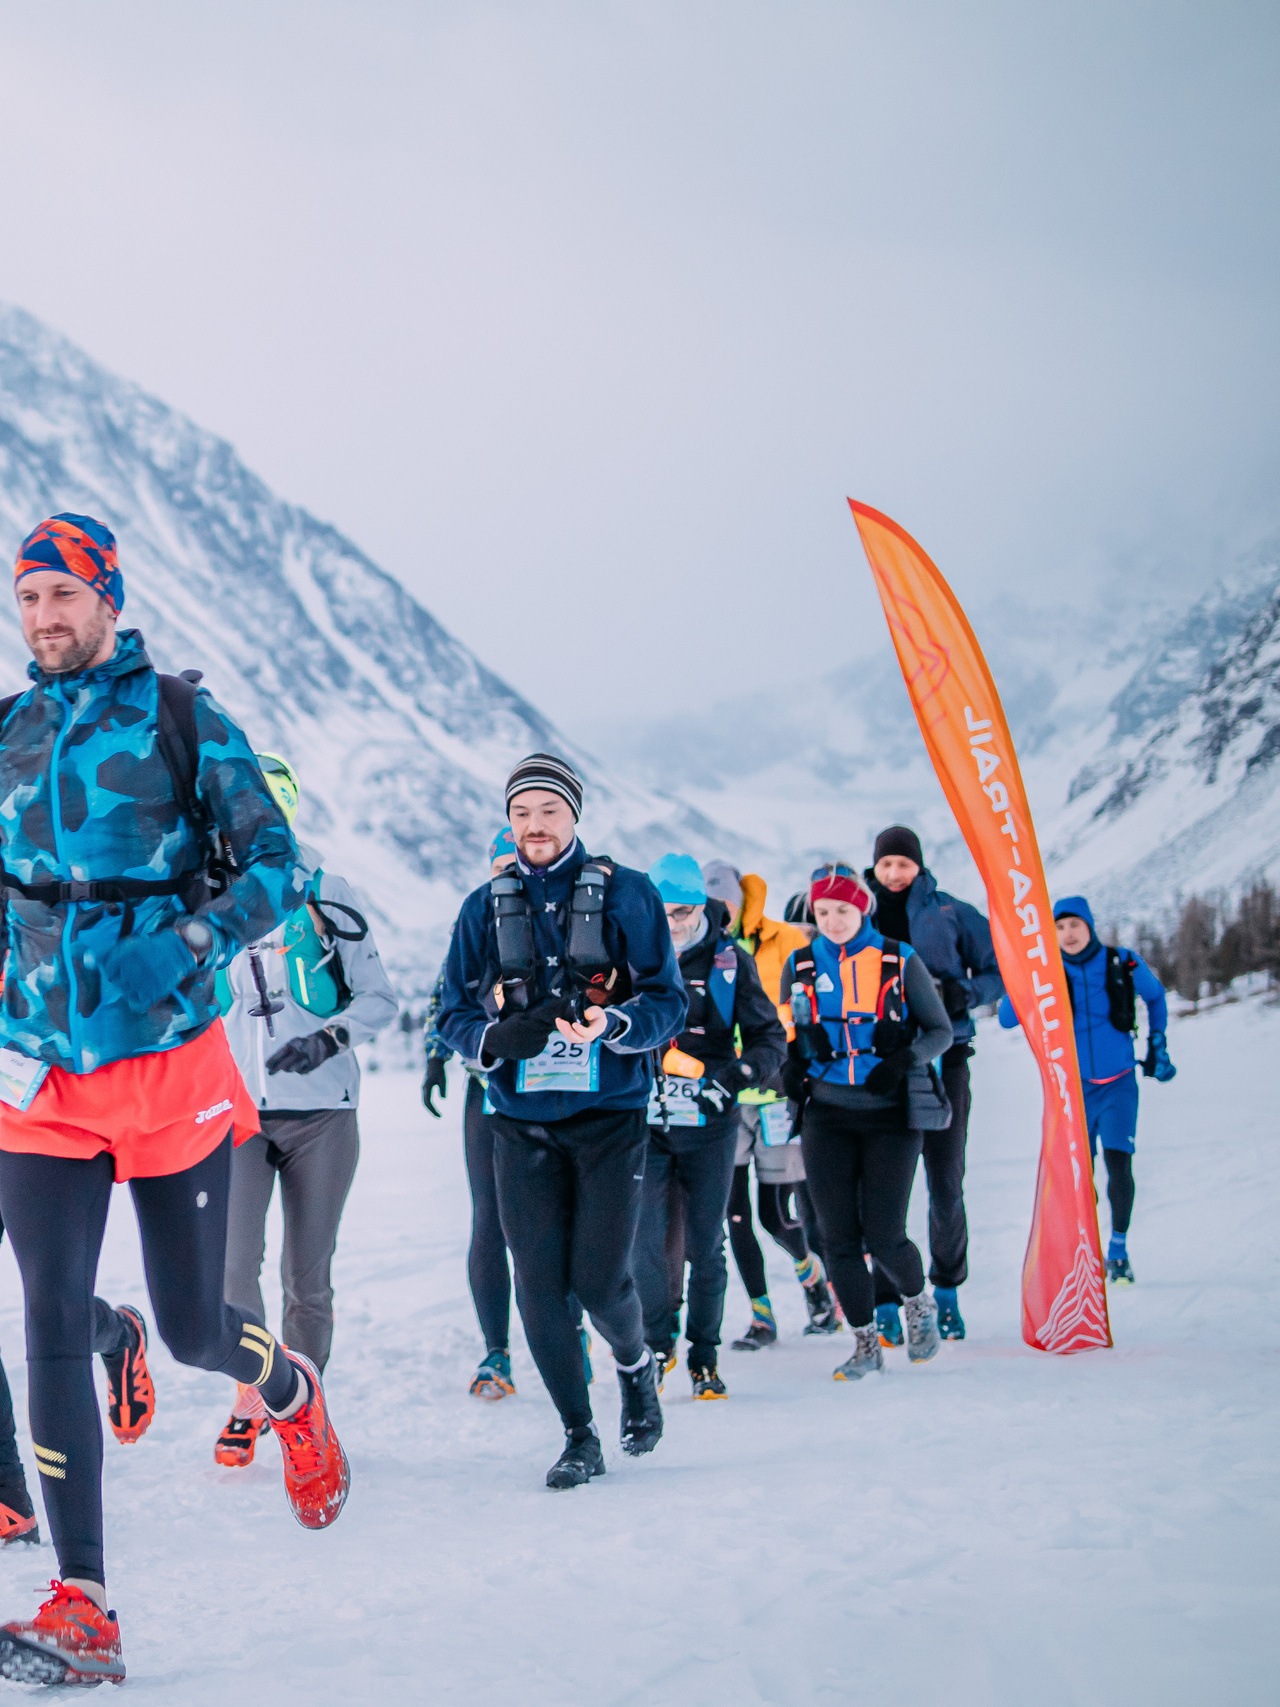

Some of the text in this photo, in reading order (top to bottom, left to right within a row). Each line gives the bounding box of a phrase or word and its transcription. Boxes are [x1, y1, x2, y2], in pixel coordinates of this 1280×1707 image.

[551, 1041, 584, 1058] 25
[667, 1081, 694, 1098] 26
[194, 1098, 234, 1124] Joma
